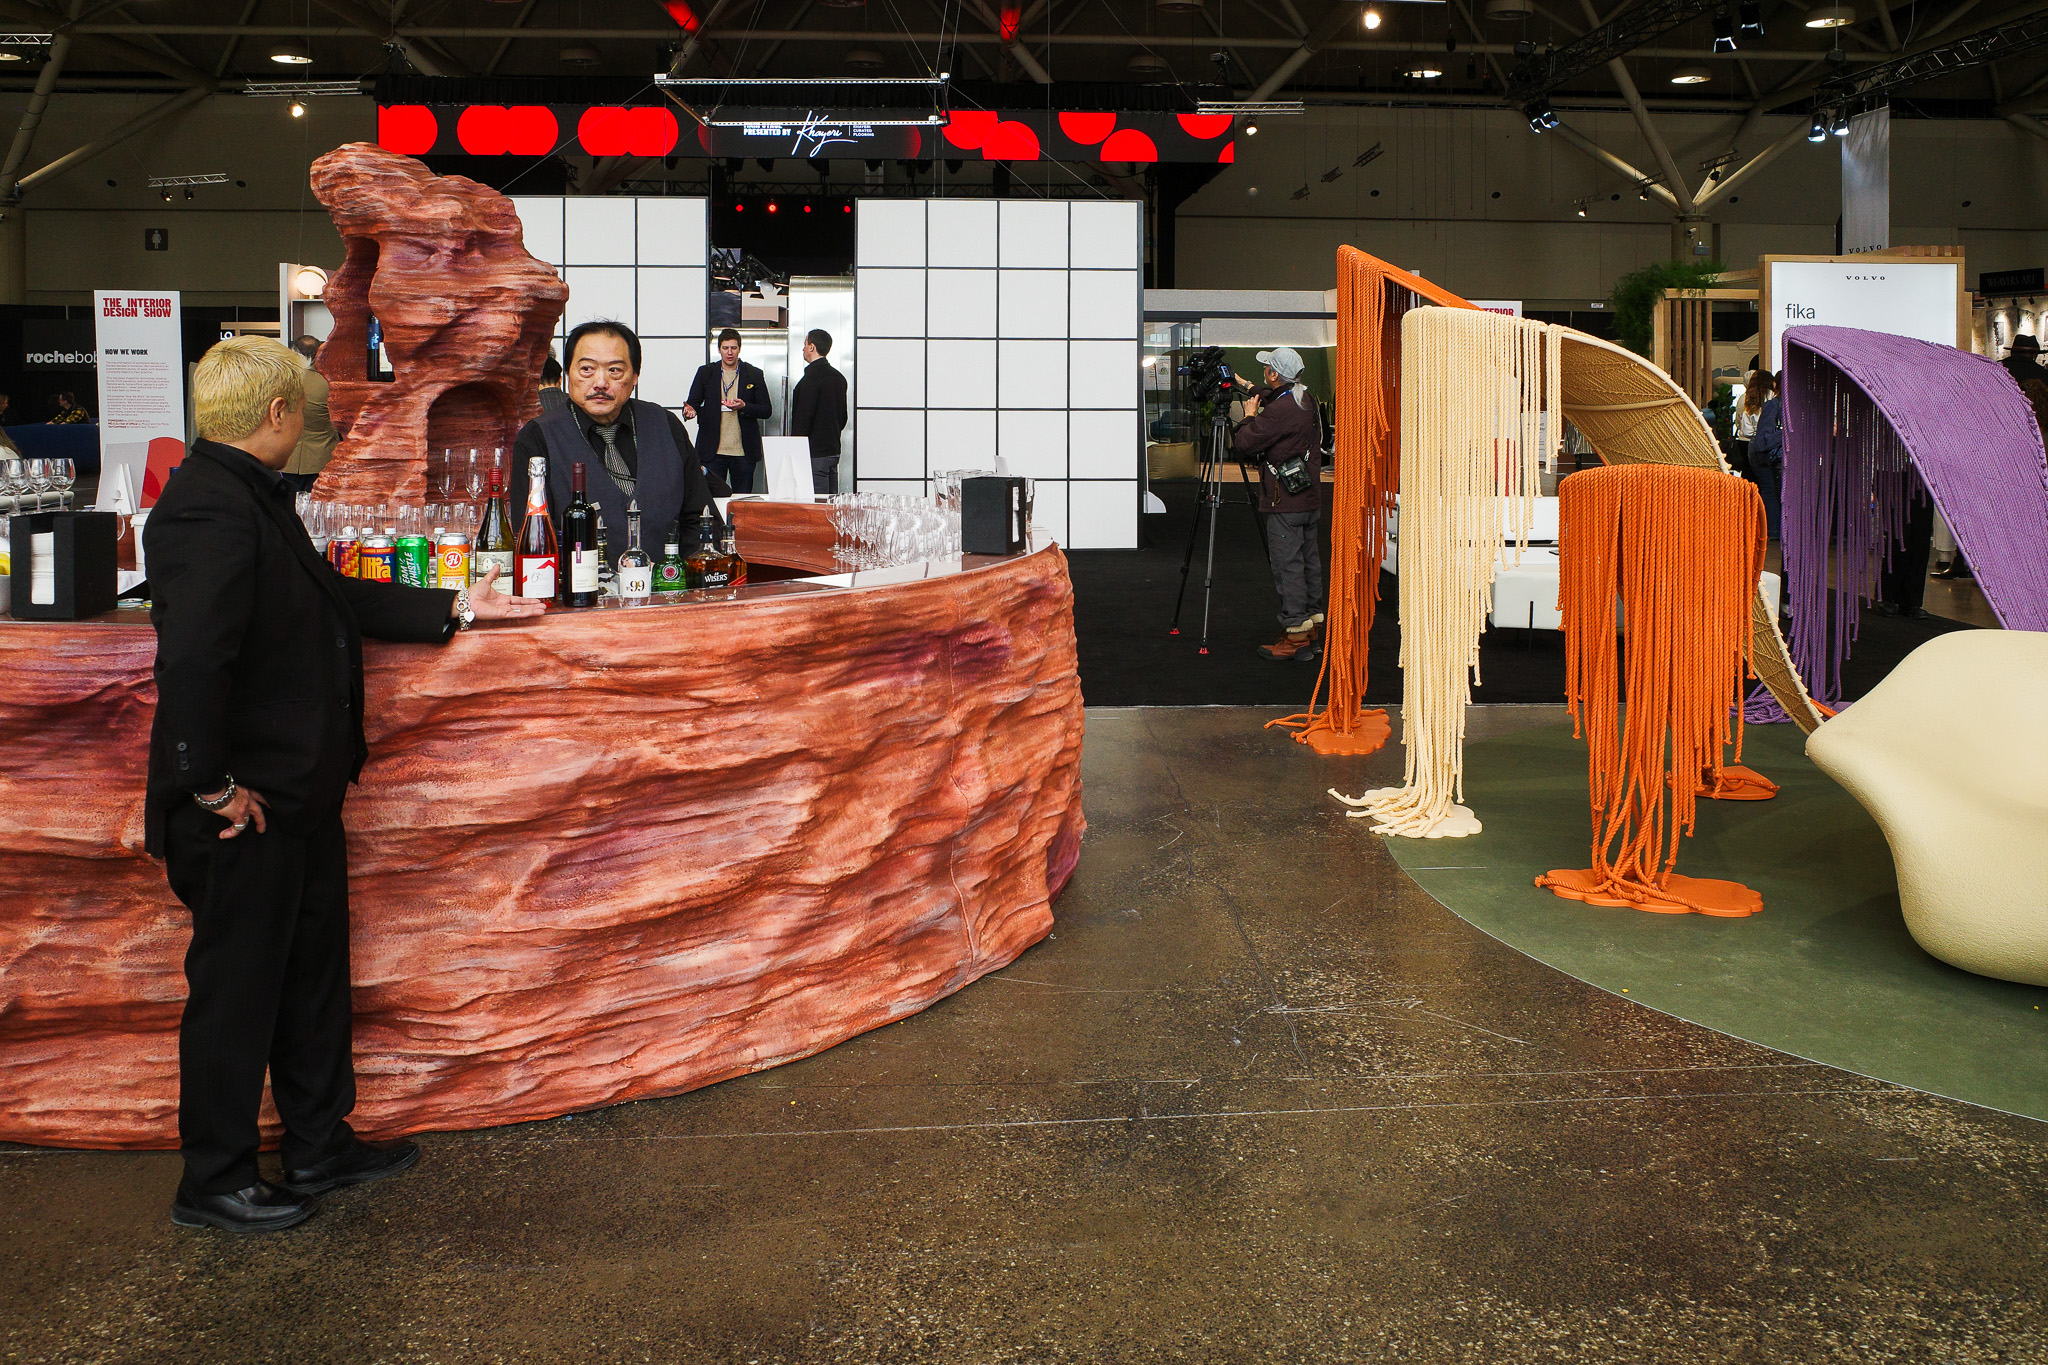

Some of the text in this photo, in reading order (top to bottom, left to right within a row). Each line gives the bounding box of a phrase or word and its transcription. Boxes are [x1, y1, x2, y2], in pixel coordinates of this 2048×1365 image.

[744, 128, 791, 136] PRESENTED BY
[791, 110, 858, 157] Khayeri
[1848, 244, 1882, 254] VOLVO
[103, 298, 172, 308] THE INTERIOR
[103, 307, 172, 318] DESIGN SHOW
[1785, 303, 1815, 319] fika
[630, 579, 645, 592] 99
